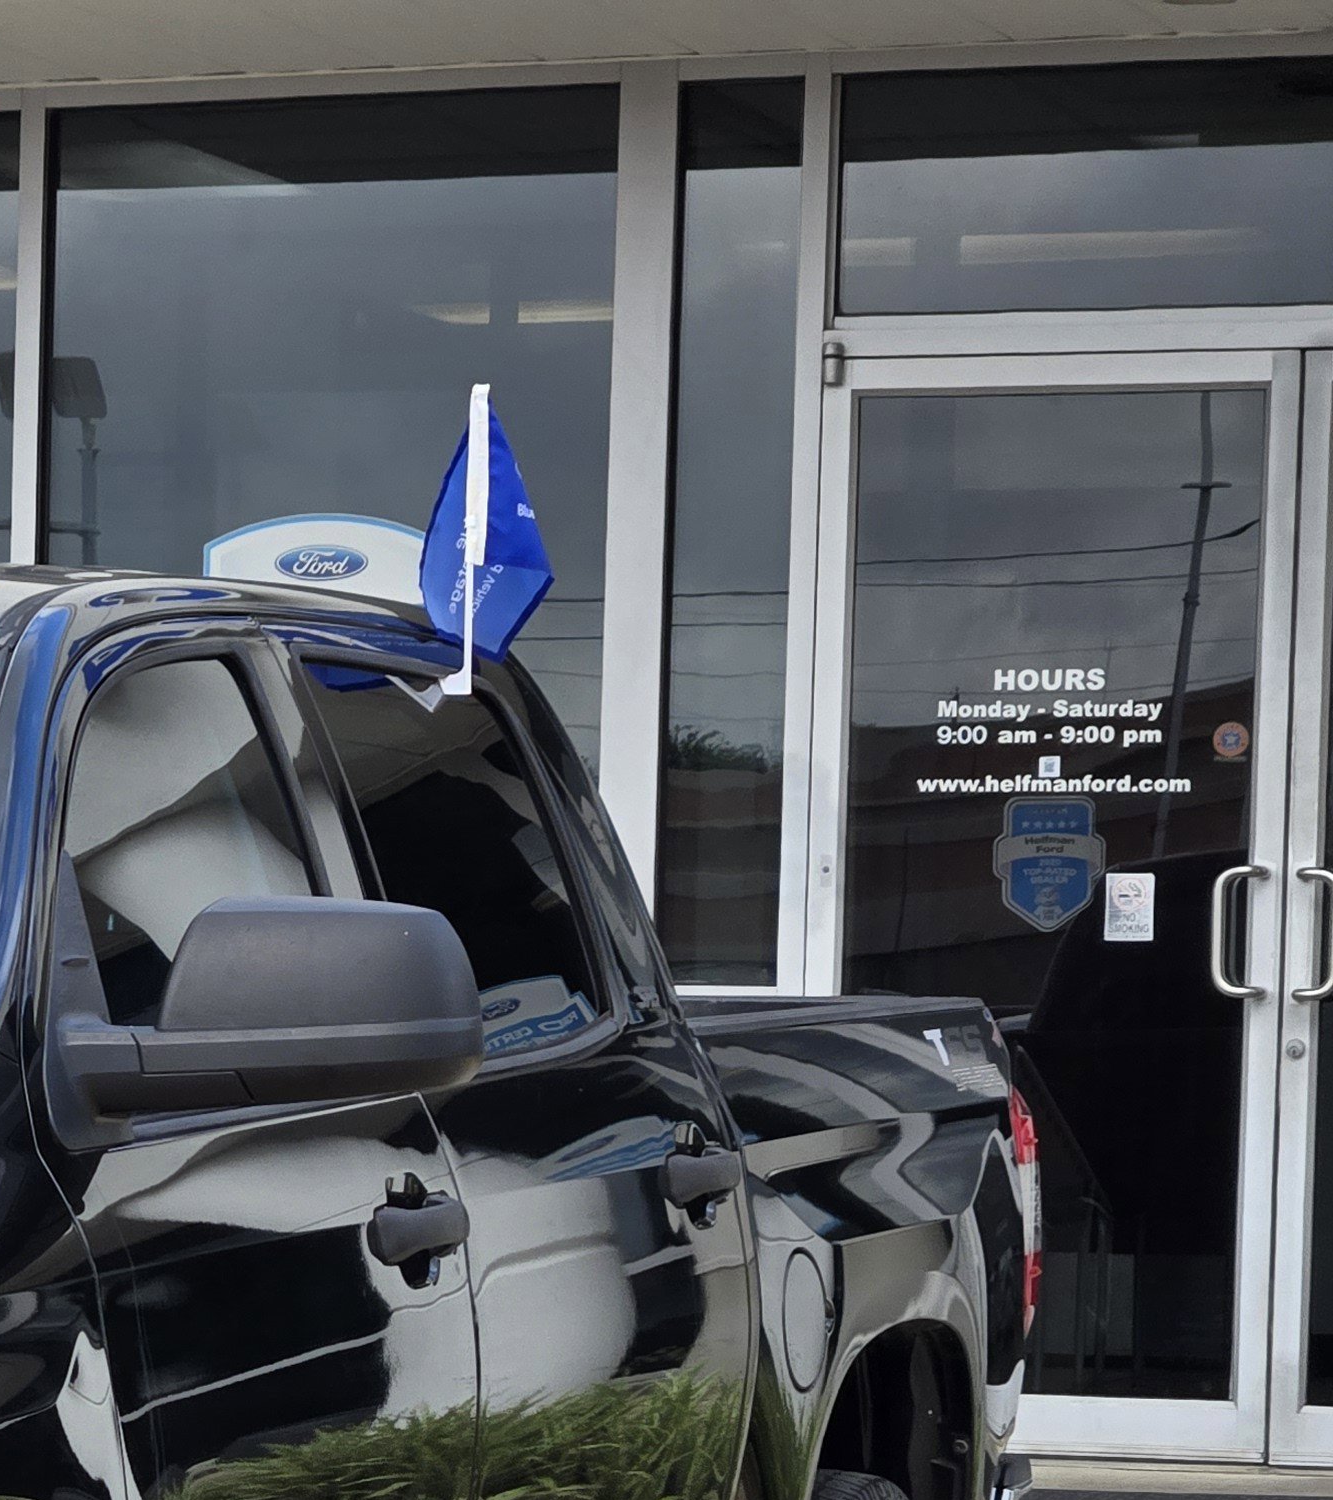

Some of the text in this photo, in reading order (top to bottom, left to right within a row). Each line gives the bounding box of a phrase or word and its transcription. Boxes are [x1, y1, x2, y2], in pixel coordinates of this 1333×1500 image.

[292, 550, 350, 575] Ford
[994, 668, 1105, 691] HOURS
[937, 701, 1031, 720] Monday
[1053, 700, 1162, 719] Saturday
[937, 726, 987, 745] 9:00
[998, 729, 1036, 744] am
[1061, 726, 1115, 744] 9:00
[1123, 728, 1162, 748] pm
[917, 774, 1191, 793] www.helfmanford.com
[1108, 924, 1149, 933] SMOKING
